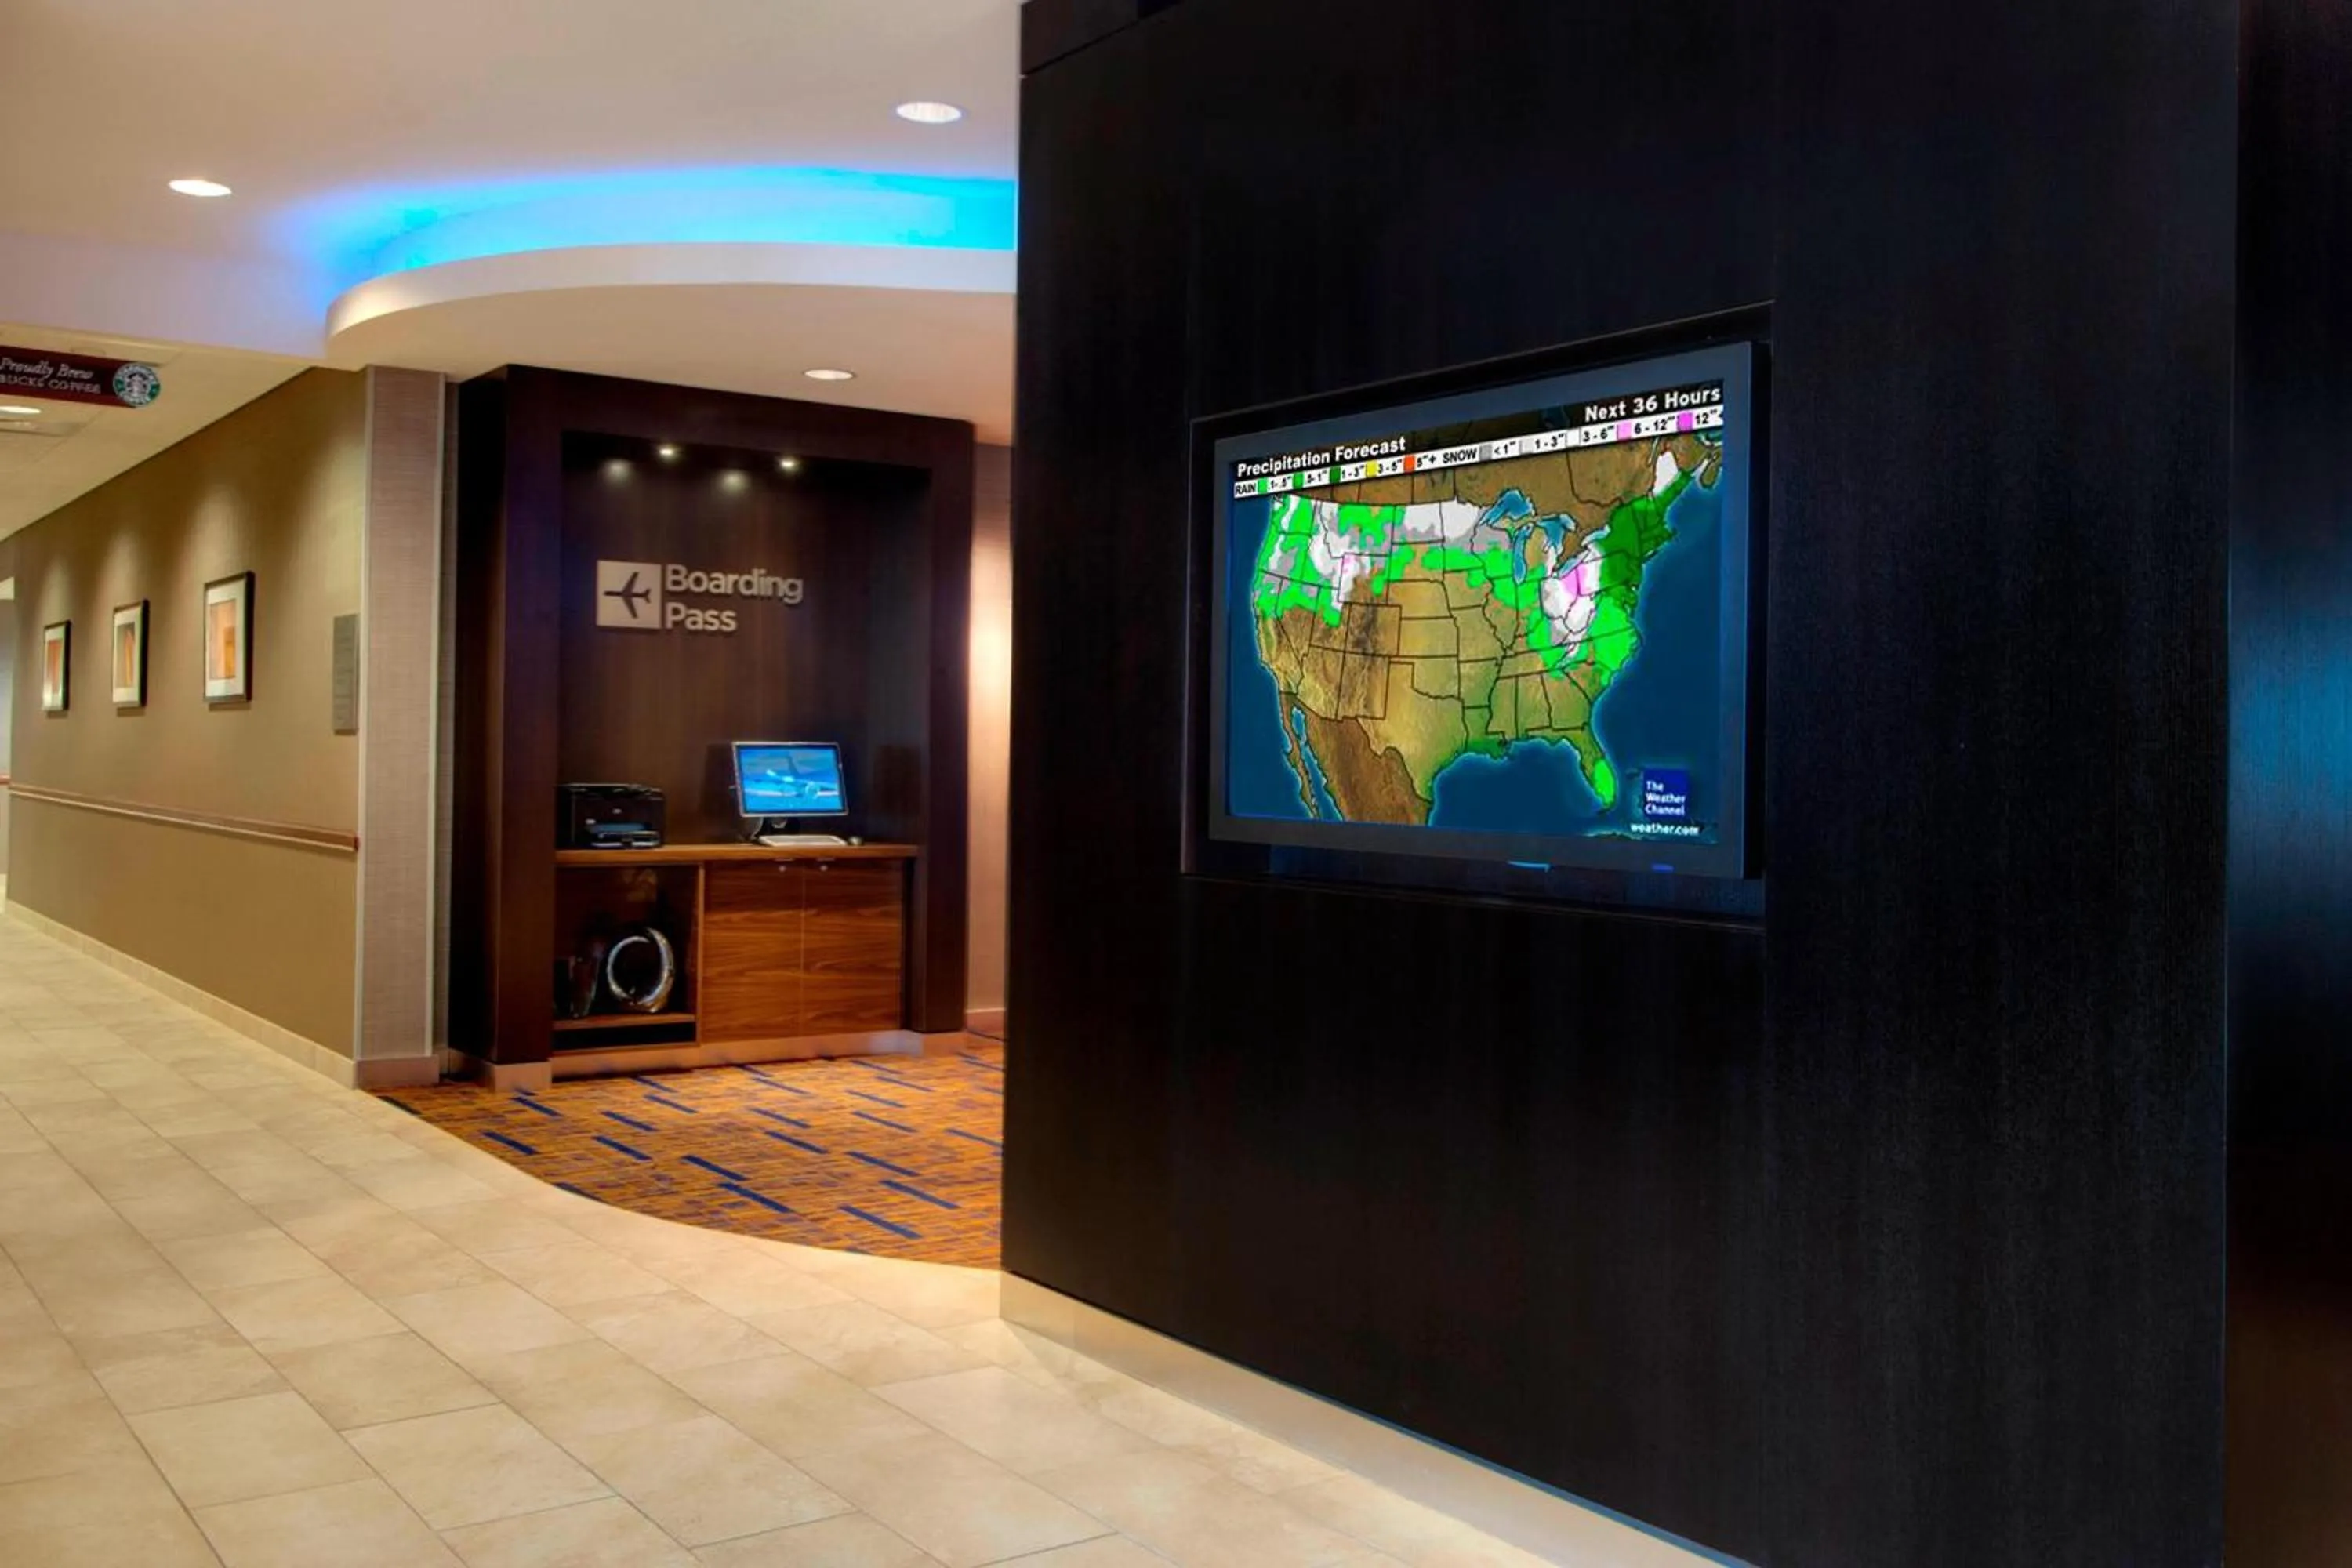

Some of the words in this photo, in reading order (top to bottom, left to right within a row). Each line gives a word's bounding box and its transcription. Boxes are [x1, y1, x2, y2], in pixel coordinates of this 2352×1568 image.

[0, 357, 54, 379] Proudly
[56, 363, 93, 379] Brew
[1585, 401, 1626, 423] Next
[1633, 395, 1658, 414] 36
[1664, 388, 1721, 408] Hours
[1237, 452, 1330, 477] Precipitation
[1335, 436, 1406, 461] Forecast
[1235, 483, 1256, 495] RAIN
[1442, 448, 1477, 463] SNOW
[666, 564, 804, 604] Boarding
[666, 601, 738, 632] Pass
[1646, 780, 1664, 793] The
[1646, 792, 1686, 804] Weather
[1645, 803, 1686, 816] Channel
[1630, 823, 1700, 836] weather.com
